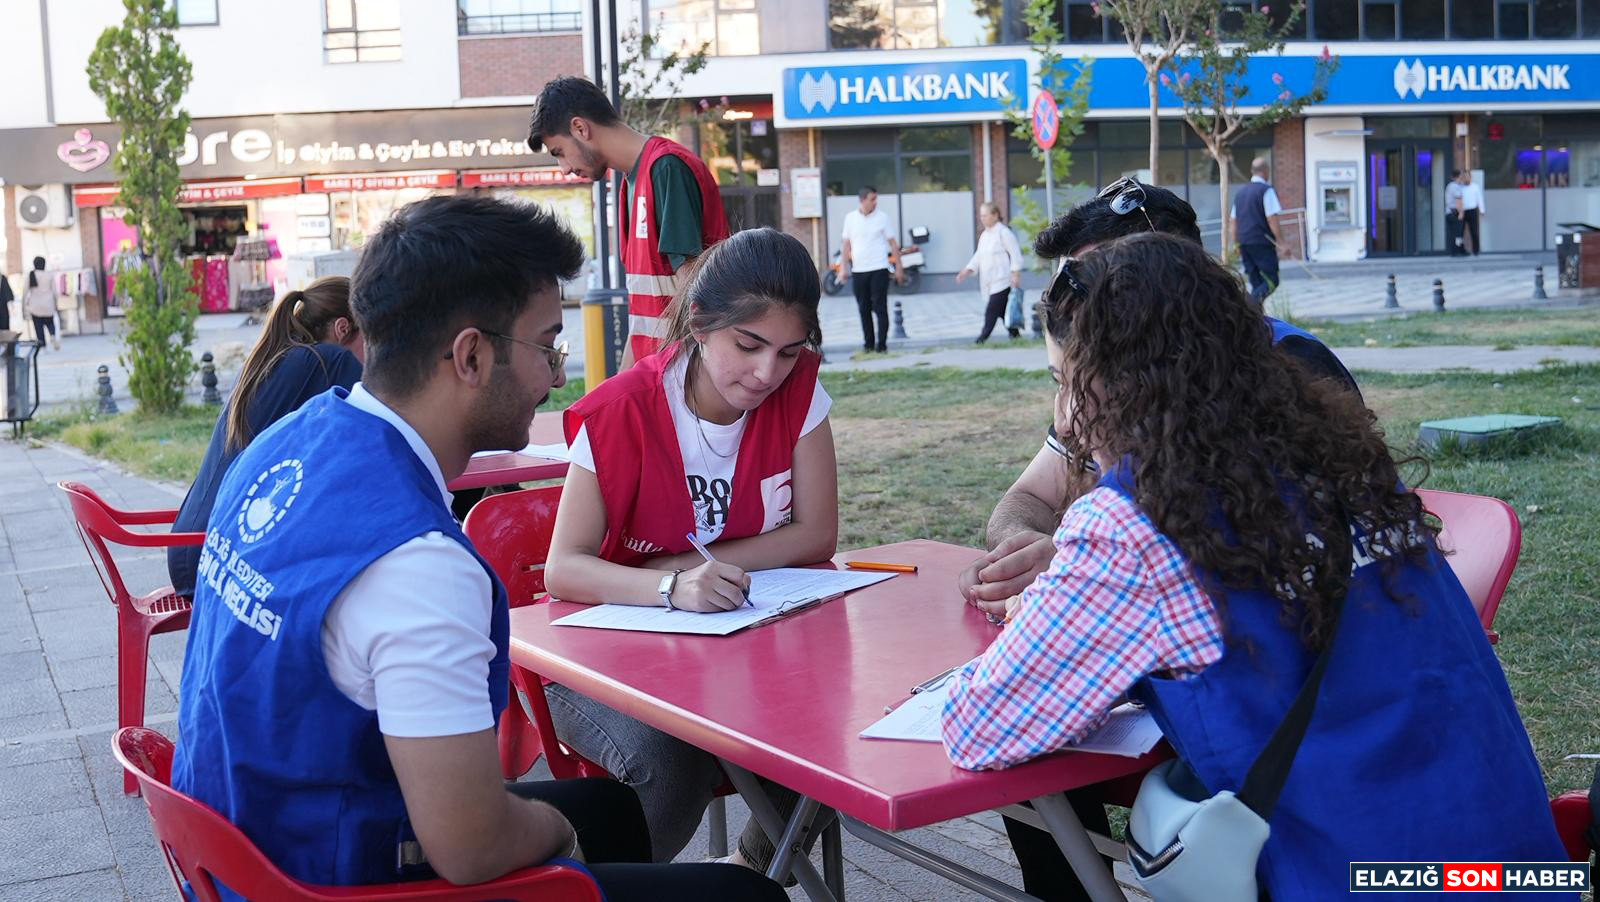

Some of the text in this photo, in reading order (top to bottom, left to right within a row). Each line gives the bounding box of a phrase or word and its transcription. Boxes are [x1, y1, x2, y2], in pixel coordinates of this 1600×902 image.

[840, 71, 1011, 104] HALKBANK
[1428, 64, 1570, 91] HALKBANK
[448, 140, 475, 157] Ev
